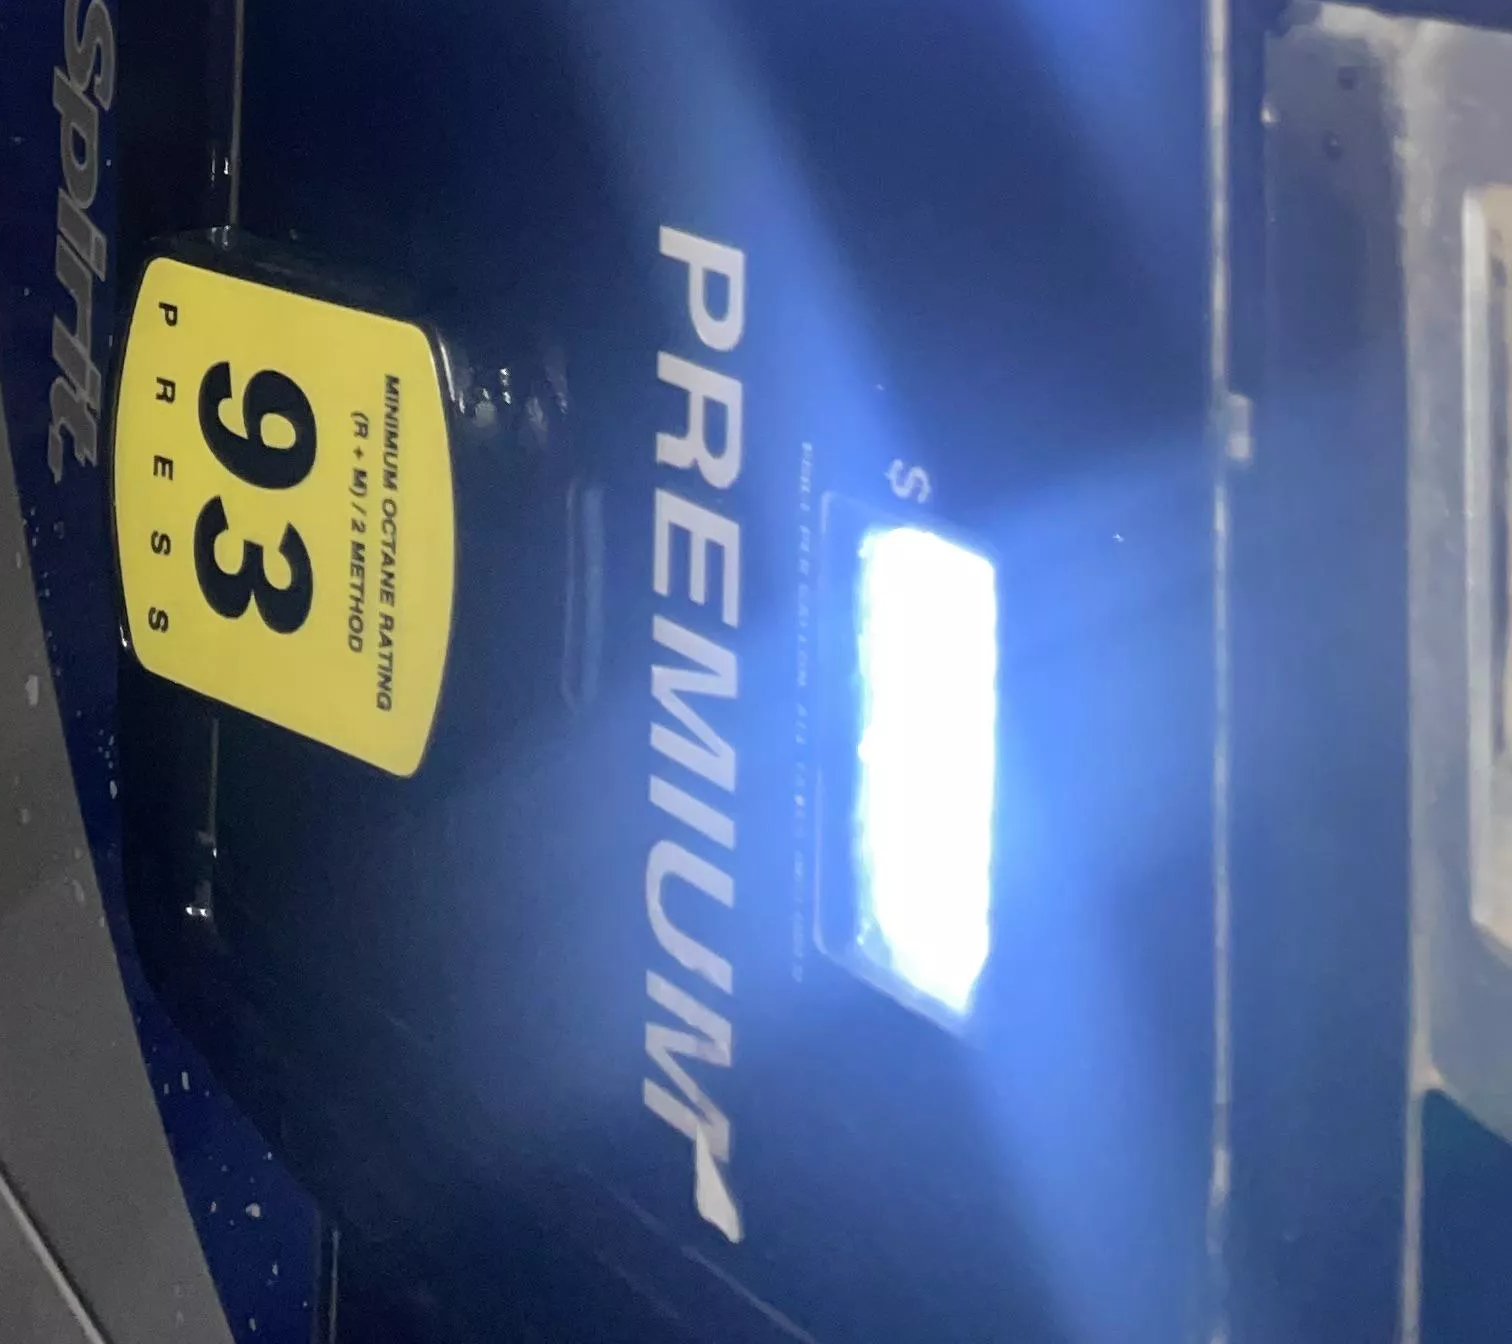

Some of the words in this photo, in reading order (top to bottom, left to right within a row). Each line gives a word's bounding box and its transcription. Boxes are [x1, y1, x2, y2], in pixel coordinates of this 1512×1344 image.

[146, 301, 177, 634] PRESS
[348, 410, 368, 441] (R
[380, 374, 401, 490] MINIMUM
[192, 360, 317, 636] 93
[346, 467, 368, 499] M)
[349, 518, 365, 535] 2
[883, 458, 931, 504] $
[346, 539, 365, 654] METHOD
[377, 497, 397, 607] OCTANE
[374, 611, 394, 713] RATING
[641, 225, 745, 1168] PREMIUM
